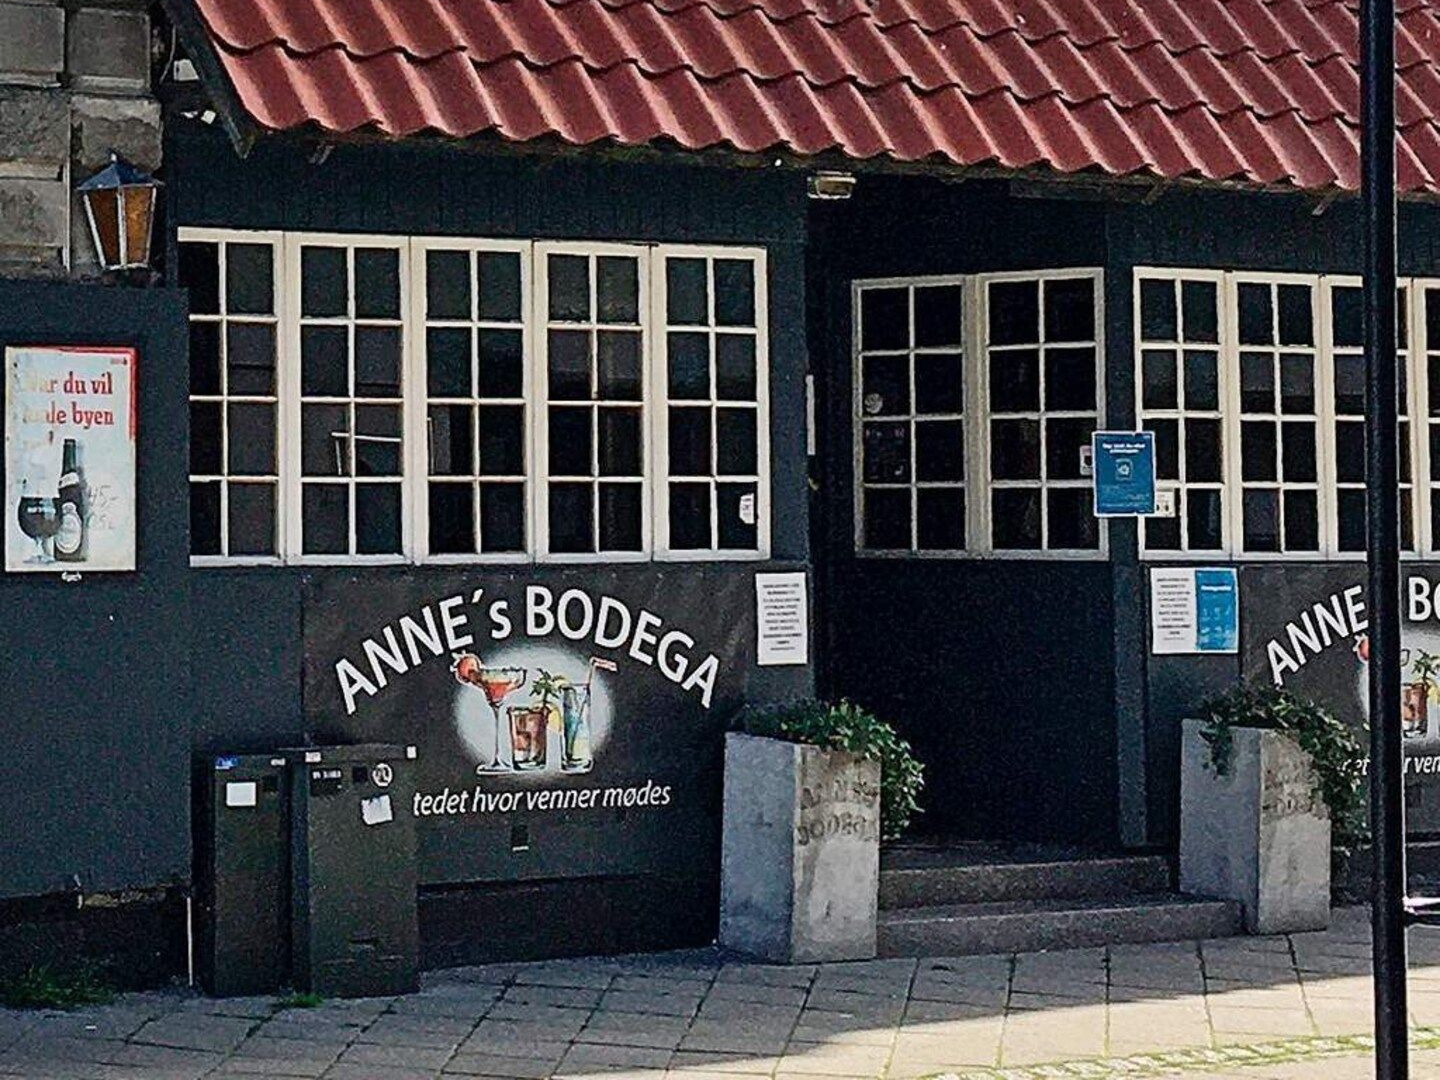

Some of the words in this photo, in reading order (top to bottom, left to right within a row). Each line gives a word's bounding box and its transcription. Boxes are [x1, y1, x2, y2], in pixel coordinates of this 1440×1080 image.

[63, 371, 87, 395] du
[90, 371, 113, 395] vil
[72, 401, 115, 430] byen
[1408, 576, 1440, 621] B
[526, 585, 719, 709] BODEGA
[413, 787, 469, 817] tedet
[472, 785, 524, 812] hvor
[526, 788, 601, 811] venner
[602, 779, 671, 807] mødes
